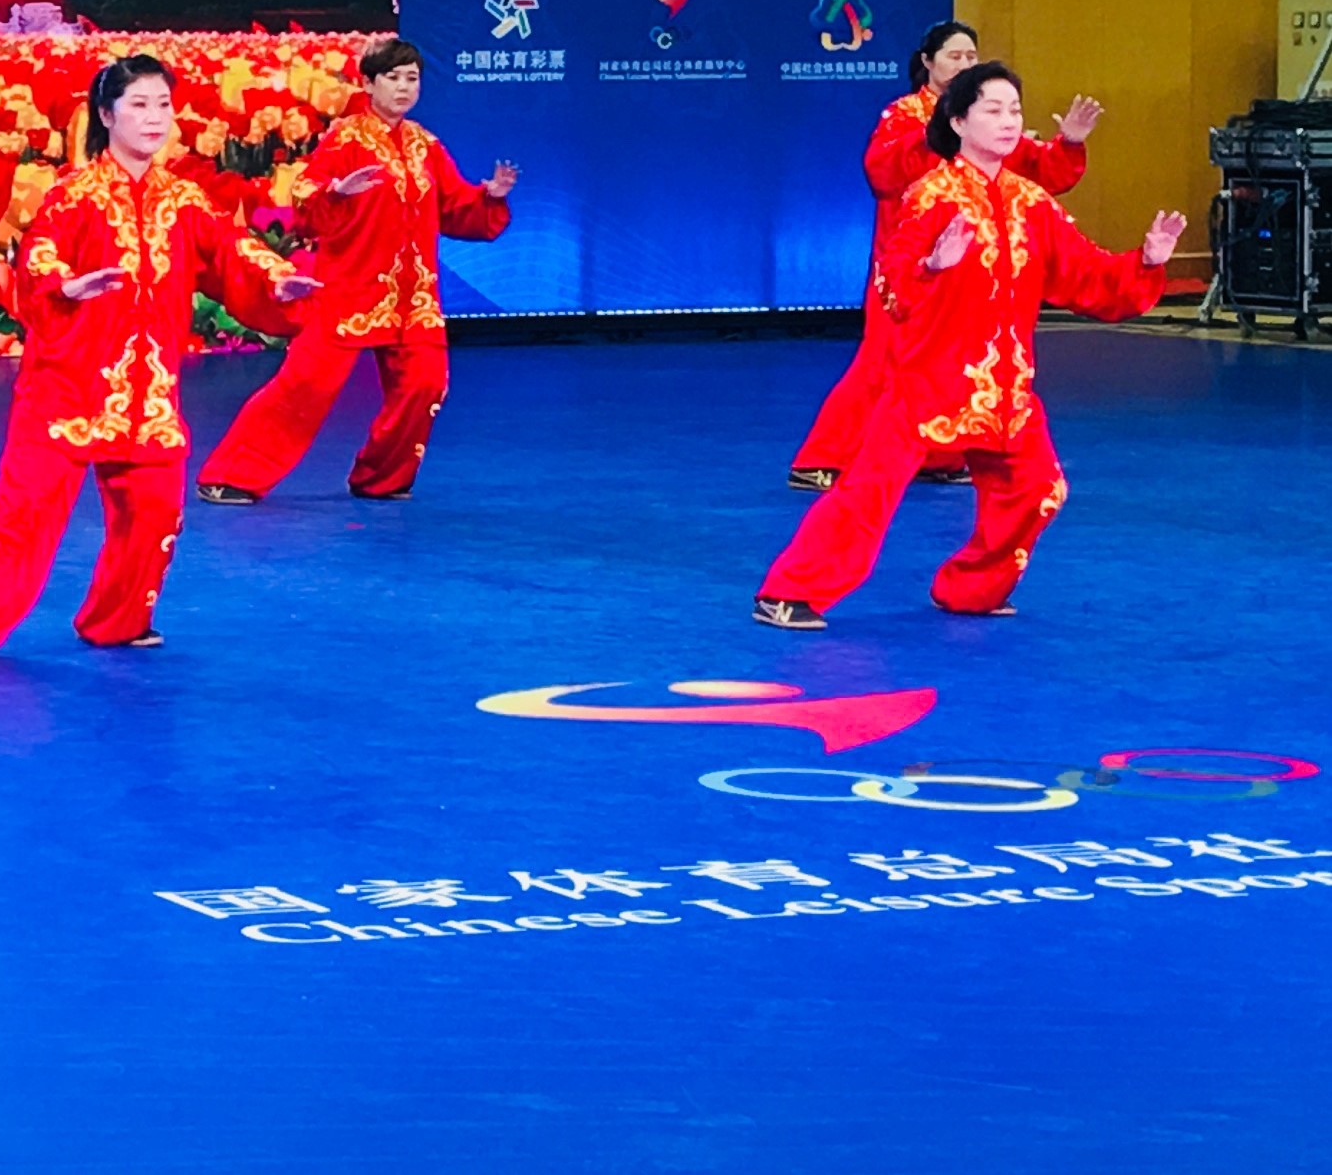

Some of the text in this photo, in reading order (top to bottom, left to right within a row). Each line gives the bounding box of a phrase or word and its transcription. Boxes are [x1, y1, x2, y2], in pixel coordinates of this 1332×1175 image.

[455, 49, 566, 70] 中国体育彩票
[240, 909, 683, 945] Chinese
[680, 884, 1095, 920] Leisure
